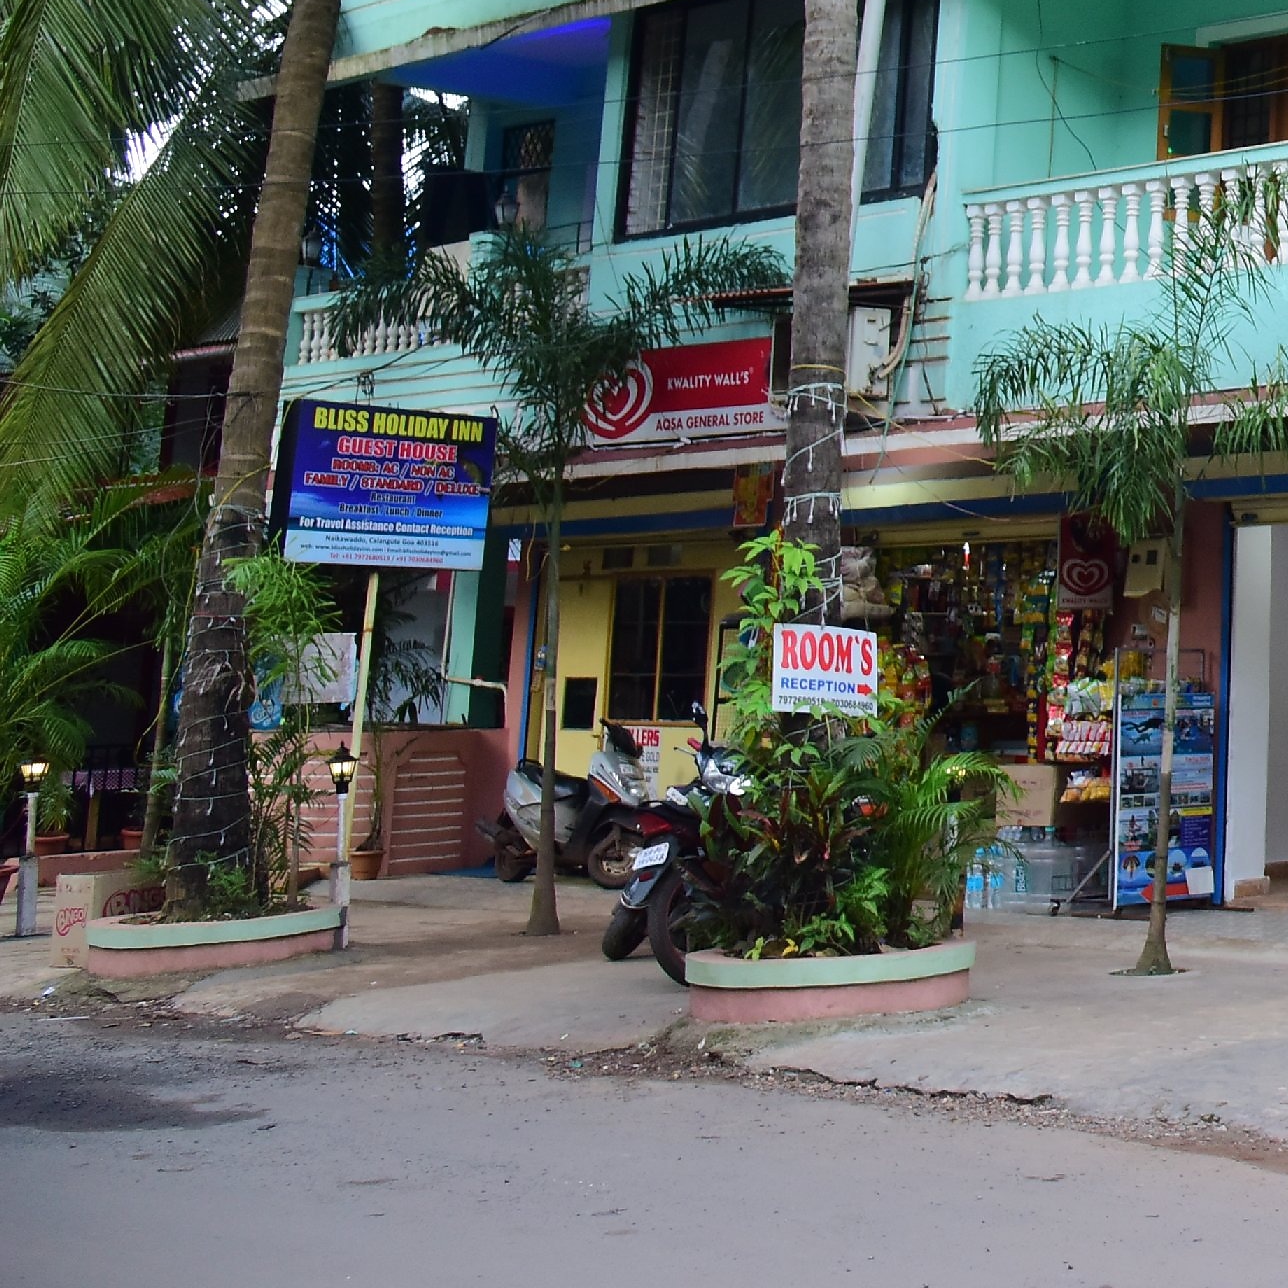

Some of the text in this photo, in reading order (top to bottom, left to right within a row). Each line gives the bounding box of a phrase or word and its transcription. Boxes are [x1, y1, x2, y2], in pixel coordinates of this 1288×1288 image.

[667, 370, 750, 391] KWALITY WALL'S
[314, 406, 484, 443] BLISS HOLIDAY INN
[655, 411, 764, 432] AQSA GENERAL STORE
[337, 436, 458, 463] GUEST HOUSE
[331, 457, 381, 474] ROOMS:
[381, 461, 400, 475] AC
[410, 464, 437, 479] NON
[437, 465, 456, 480] AC
[304, 471, 351, 488] FAMILY
[360, 475, 425, 494] STANDARD
[434, 481, 481, 497] DELUXE
[370, 491, 416, 505] Restaurant
[339, 502, 379, 515] Breakfast
[385, 505, 410, 517] Lunch
[416, 507, 444, 519] Dinner
[299, 515, 473, 536] For Travel Assistance Contact Reception
[780, 629, 873, 676] ROOM'S
[780, 676, 856, 694] RECEPTION
